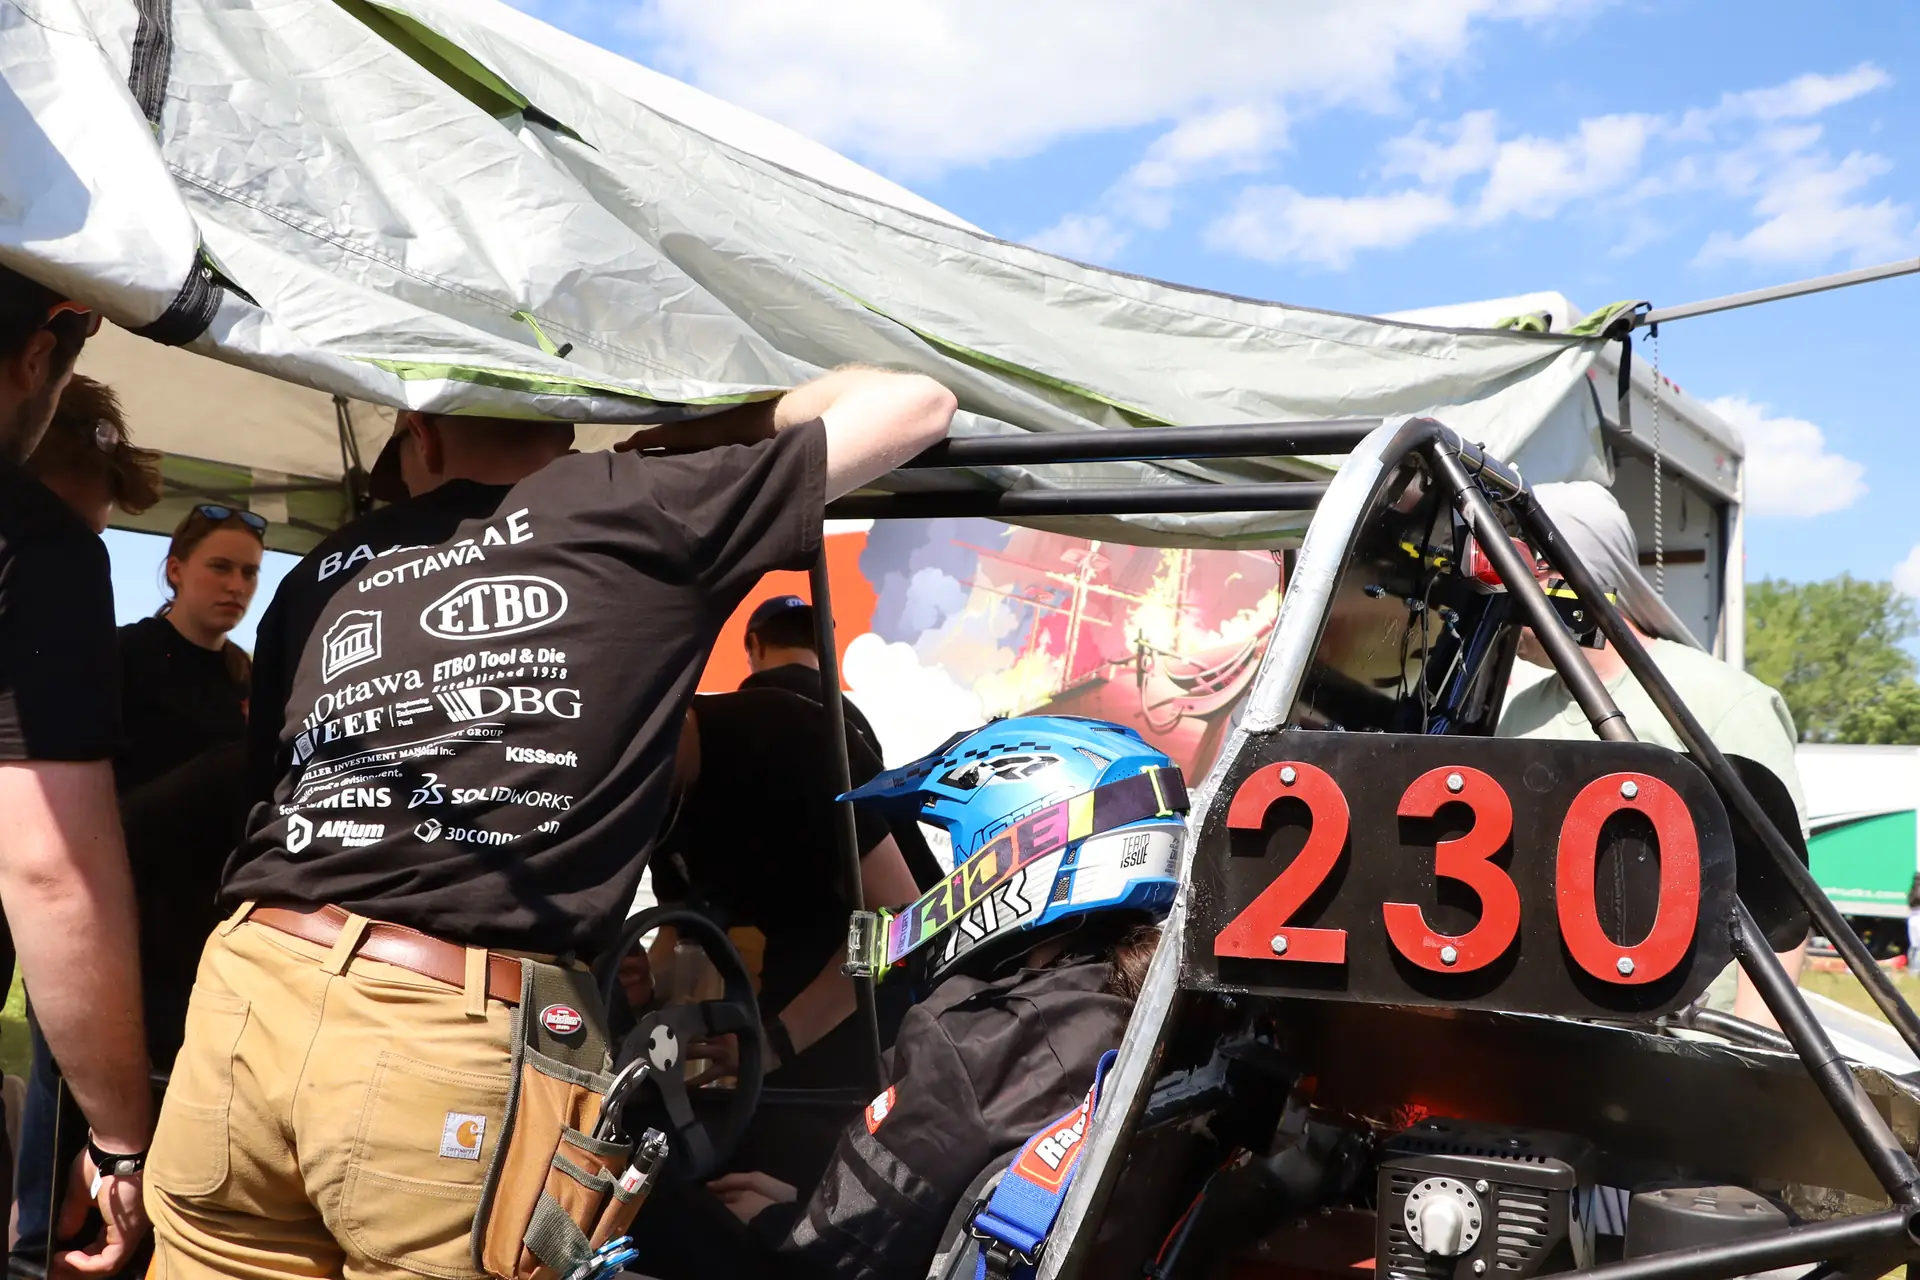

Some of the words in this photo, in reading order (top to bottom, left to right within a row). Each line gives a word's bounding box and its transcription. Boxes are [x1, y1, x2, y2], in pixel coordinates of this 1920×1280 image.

[358, 543, 486, 593] uOTTAWA
[438, 583, 550, 634] ETBO
[432, 653, 477, 683] ETBO
[479, 648, 517, 669] Tool
[519, 648, 534, 664] &
[537, 647, 566, 664] Die
[432, 667, 525, 693] Established
[532, 666, 568, 680] 1958
[303, 669, 425, 731] uOttawa
[438, 686, 584, 722] DBG
[334, 752, 397, 773] INVESTMENT
[466, 728, 504, 738] GROUP
[439, 746, 456, 756] Inc.
[505, 746, 579, 768] KISSsoft
[450, 786, 574, 811] SOLIDWORKS
[316, 820, 385, 838] Altium
[1122, 833, 1151, 859] TEAM
[1213, 760, 1700, 986] 230
